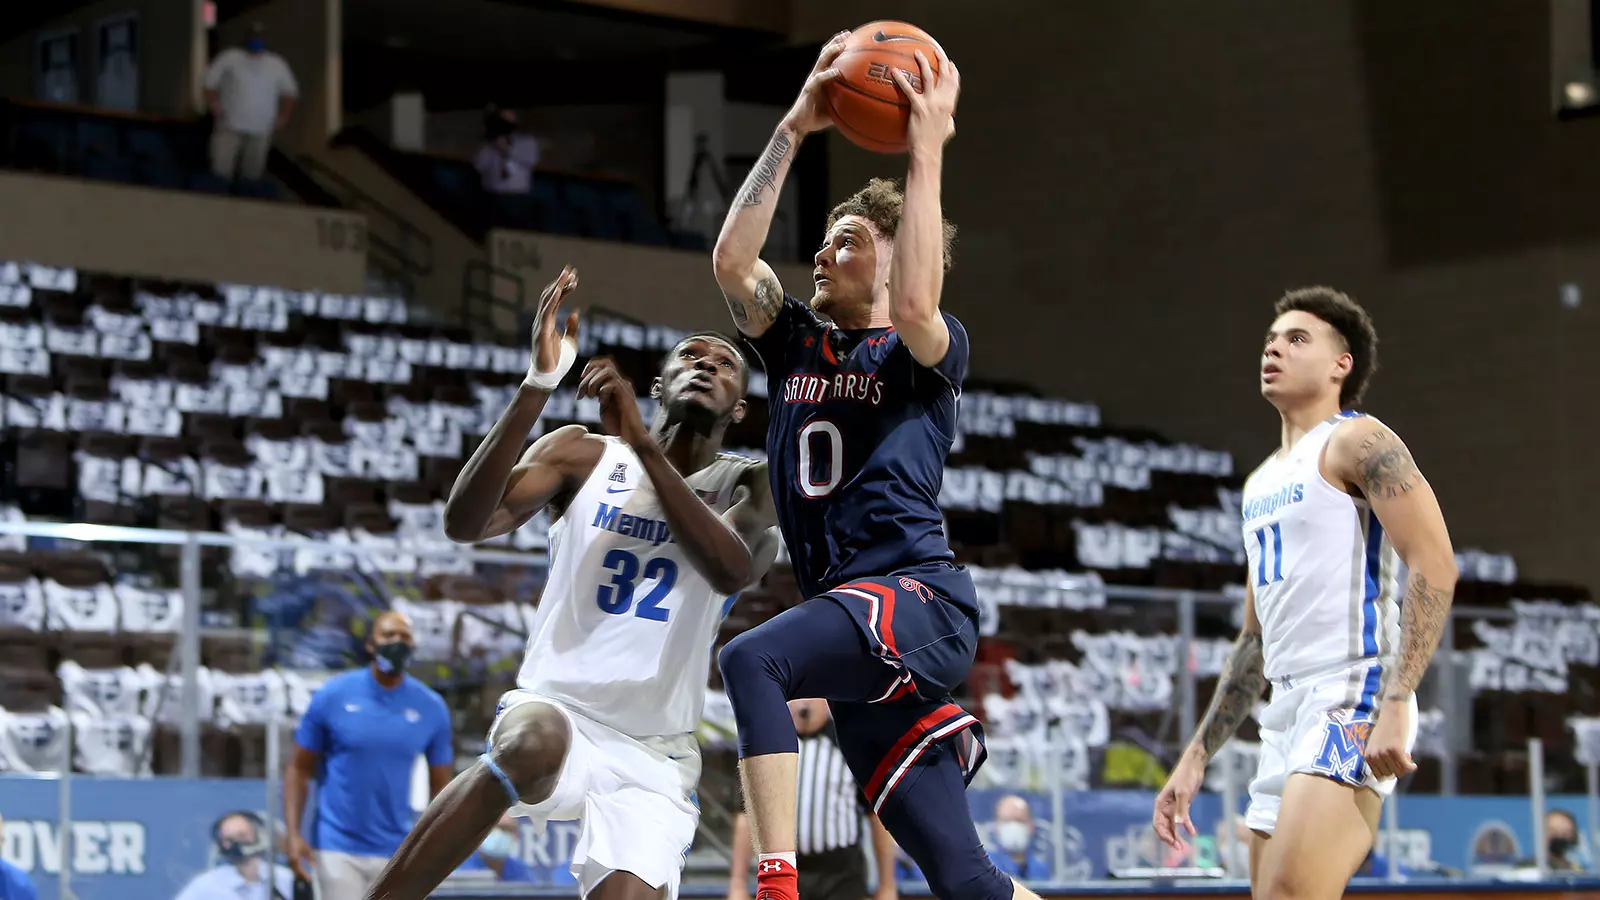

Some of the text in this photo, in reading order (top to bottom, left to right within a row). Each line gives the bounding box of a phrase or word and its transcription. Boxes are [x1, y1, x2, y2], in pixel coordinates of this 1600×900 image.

[316, 217, 366, 252] 103
[497, 239, 542, 270] 104
[784, 373, 886, 407] SAINT ARY'S
[798, 418, 844, 499] 0
[1243, 482, 1304, 521] Memphis
[592, 502, 677, 546] Memp
[1254, 523, 1285, 587] 11
[597, 549, 679, 622] 32
